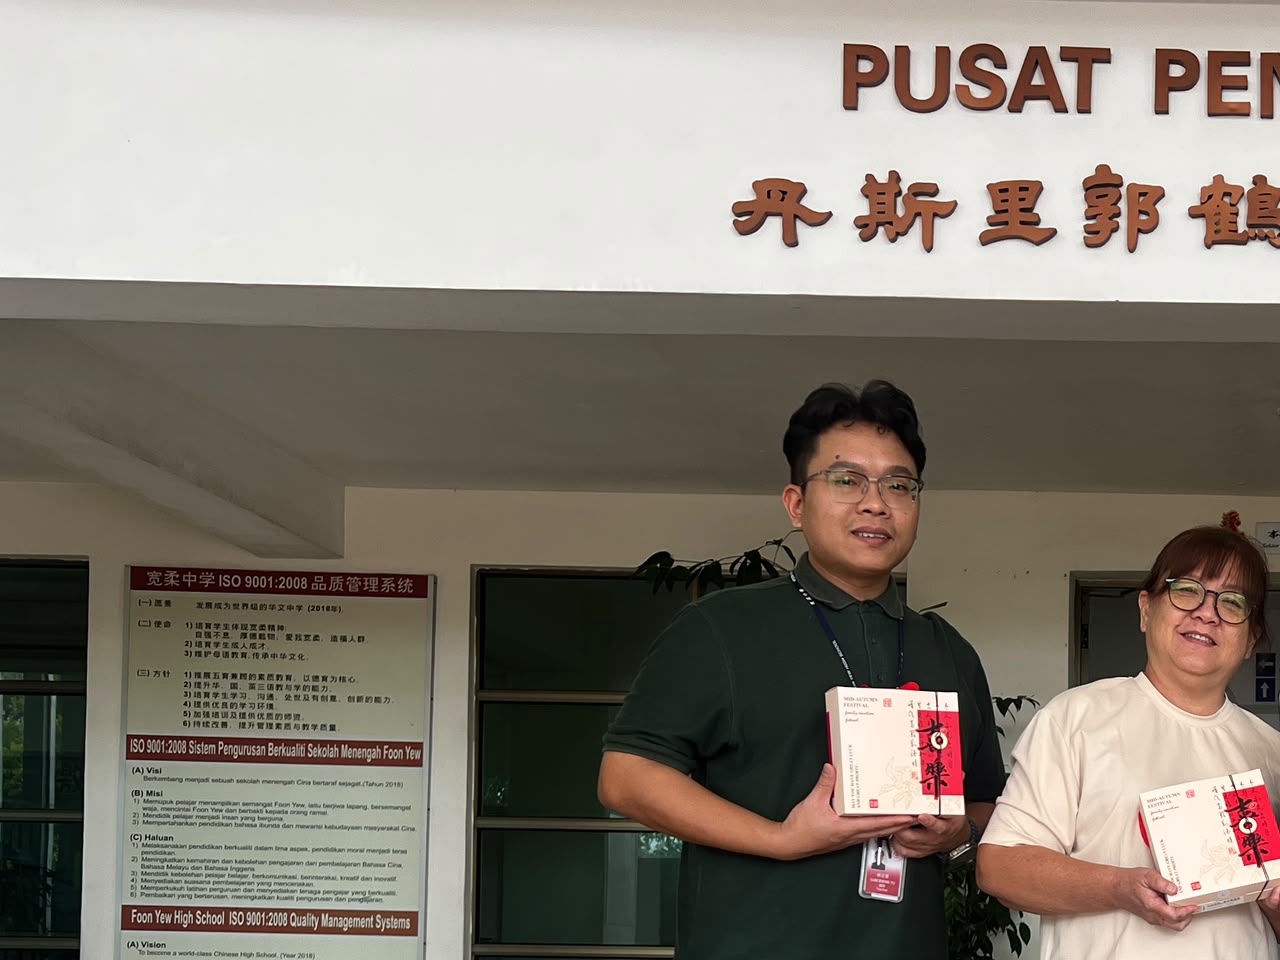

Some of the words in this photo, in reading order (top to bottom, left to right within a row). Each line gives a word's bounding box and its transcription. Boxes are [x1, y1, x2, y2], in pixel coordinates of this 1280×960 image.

[842, 43, 1112, 114] PUSAT
[146, 571, 215, 587] 宽柔中学
[219, 575, 241, 588] ISO
[244, 575, 308, 590] 9001:2008
[311, 576, 414, 593] 品质管理系统
[130, 738, 144, 752] ISO
[146, 738, 186, 753] 9001:2008
[188, 740, 216, 754] Sistem
[218, 740, 265, 758] Pengurusan
[267, 742, 305, 756] Berkualiti
[307, 742, 339, 757] Sekolah
[340, 743, 381, 761] Menengah
[383, 744, 403, 759] Foon
[405, 745, 421, 759] Yew
[132, 767, 144, 775] (A)
[146, 767, 162, 775] Visi
[131, 790, 143, 798] (B)
[1146, 792, 1181, 804] MID-AUTUMN
[1148, 800, 1172, 809] FESTIVAL
[130, 834, 142, 842] (C)
[144, 834, 174, 842] Haluan
[131, 910, 152, 924] Foon
[155, 910, 172, 924] Yew
[173, 910, 193, 928] High
[195, 911, 224, 926] School
[228, 912, 244, 926] ISO
[246, 912, 287, 927] 9001:2008
[289, 913, 318, 930] Quality
[321, 914, 373, 932] Management
[375, 915, 410, 932] Systems
[126, 941, 139, 949] (A)
[140, 941, 166, 949] Vision
